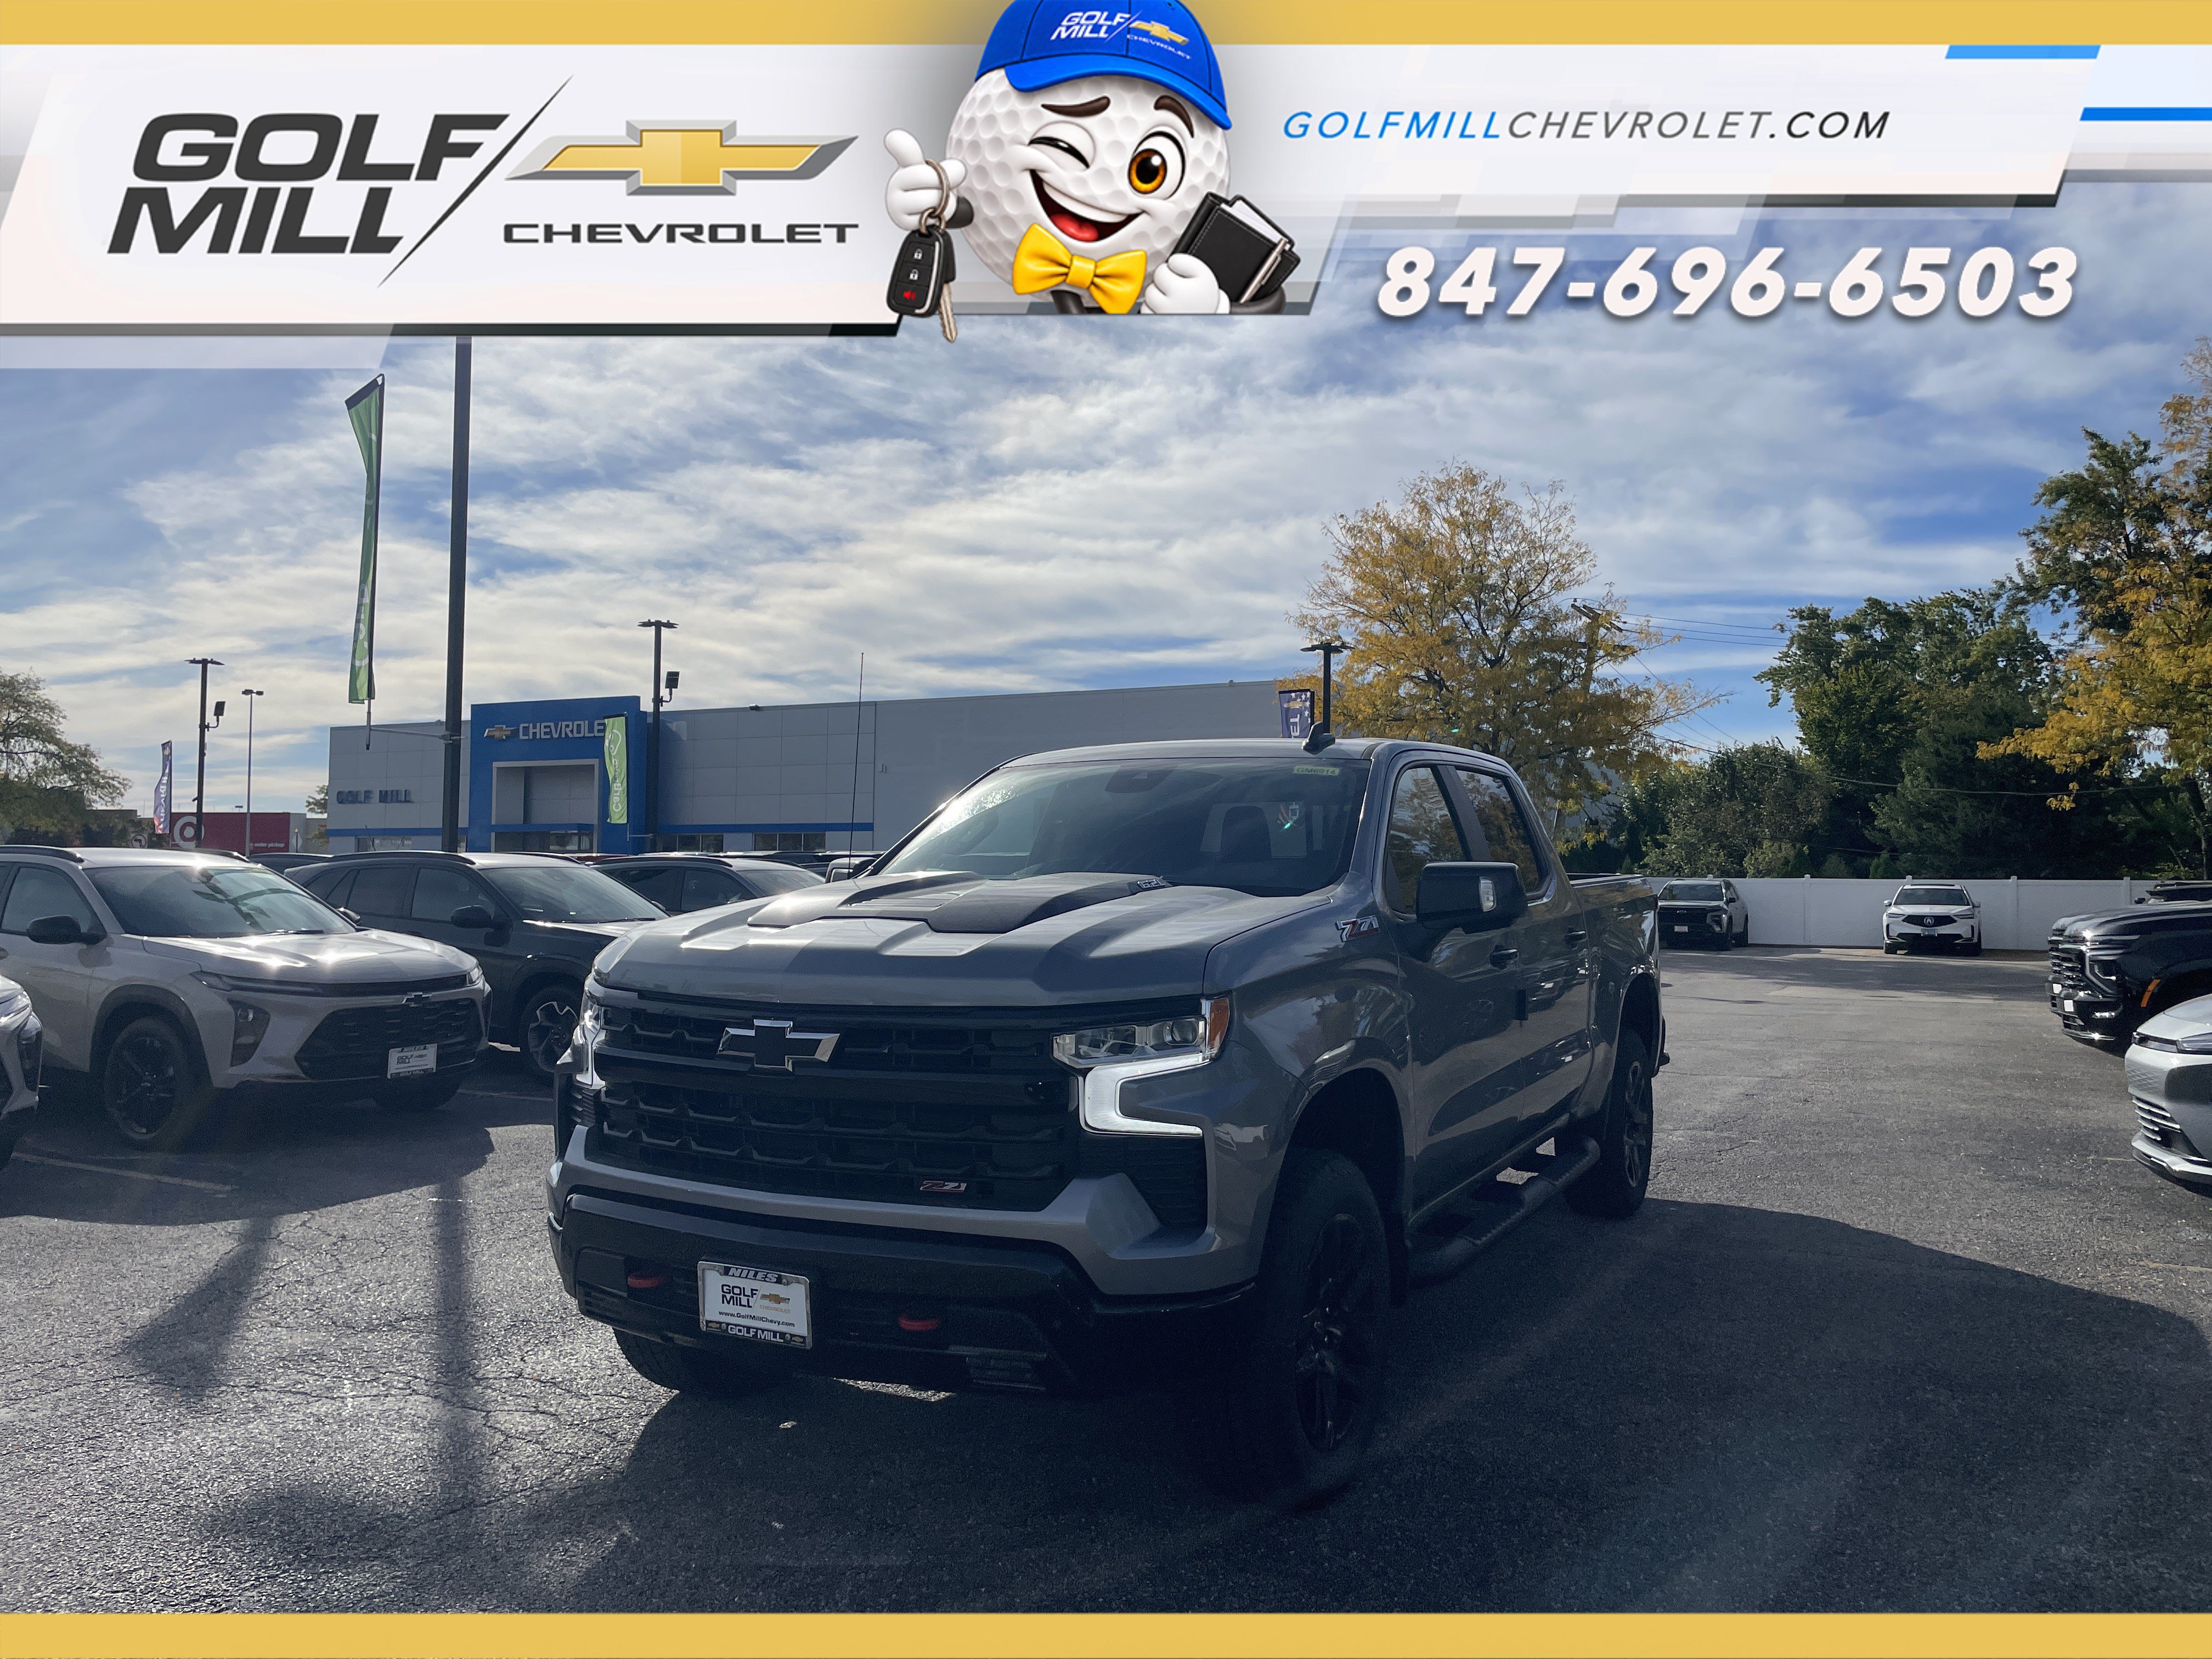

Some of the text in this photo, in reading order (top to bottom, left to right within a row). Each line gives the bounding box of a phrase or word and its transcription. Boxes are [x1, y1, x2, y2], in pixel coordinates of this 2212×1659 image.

[519, 719, 606, 740] CHEVROLE
[336, 789, 414, 804] GOLF MILL
[1335, 915, 1379, 943] Z71
[920, 1180, 967, 1193] Z71
[728, 1267, 778, 1283] NILES
[721, 1284, 759, 1299] GOLF
[721, 1294, 752, 1308] MILL
[718, 1310, 795, 1328] www.GolfMillChevy.com
[727, 1324, 784, 1342] GOLF MILL
